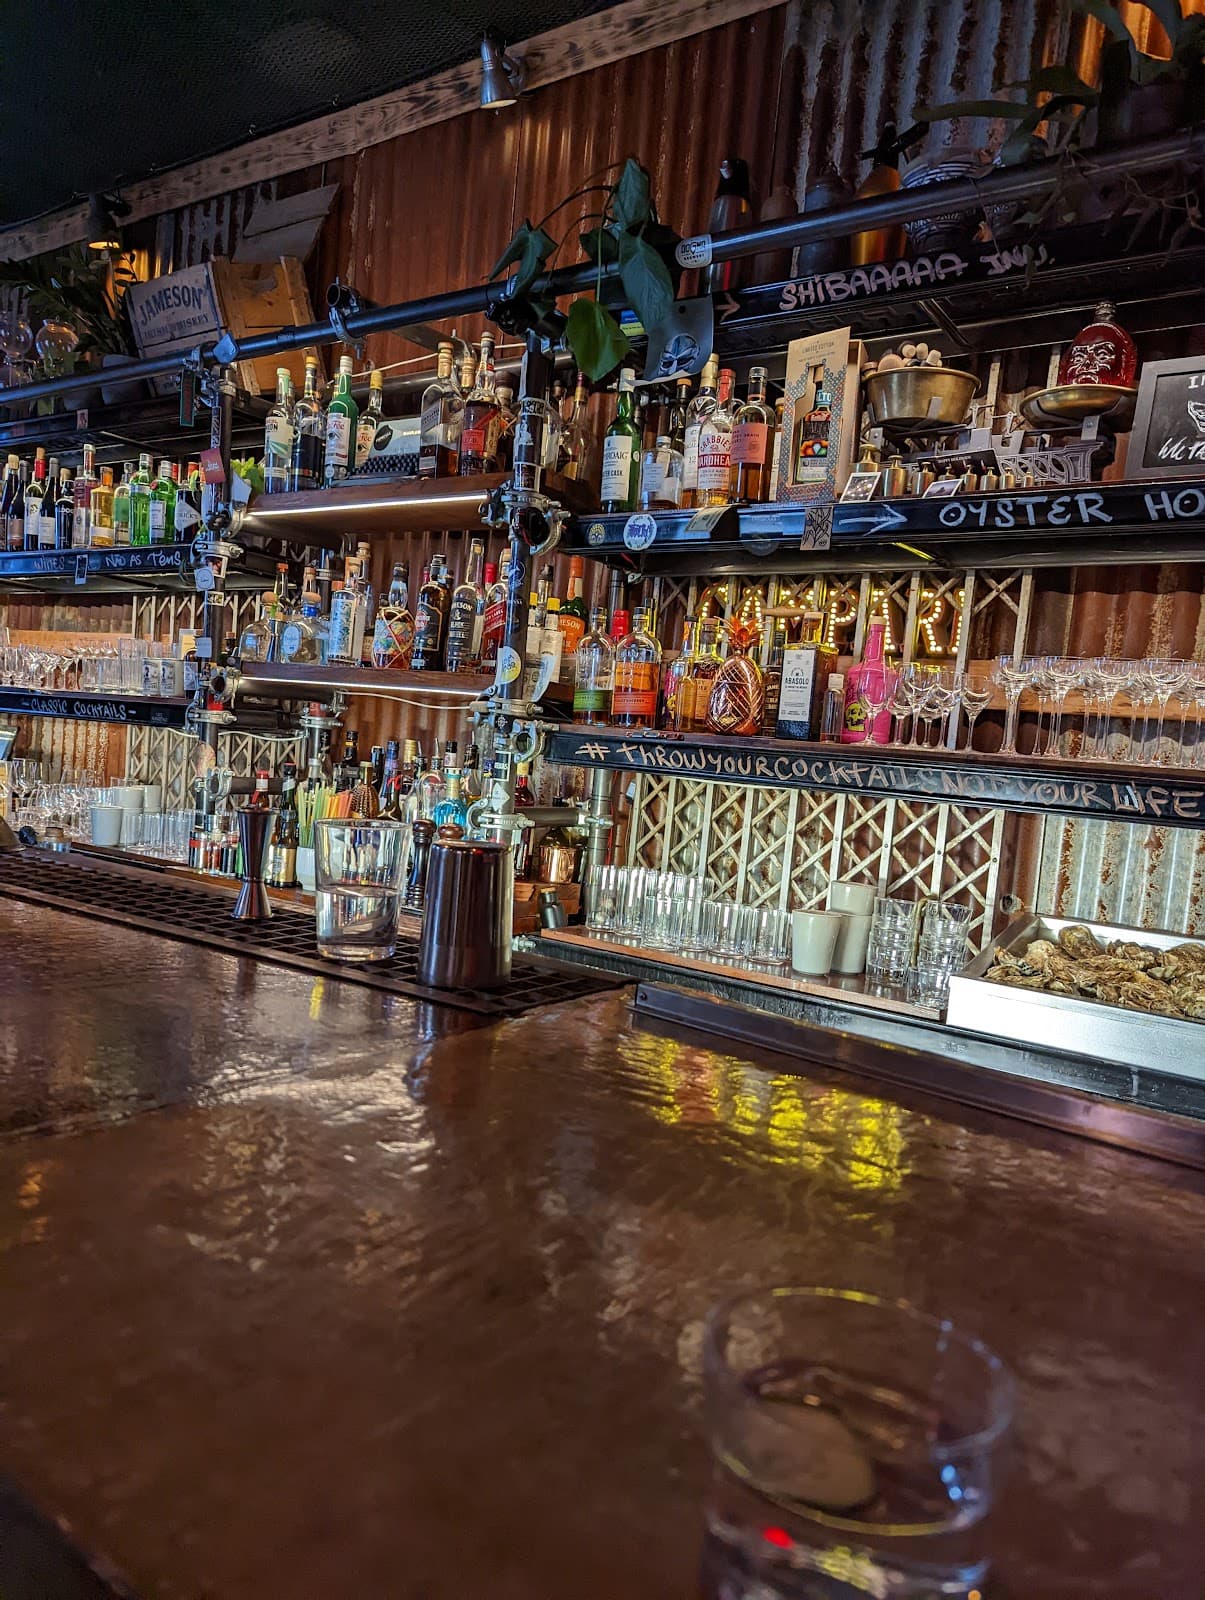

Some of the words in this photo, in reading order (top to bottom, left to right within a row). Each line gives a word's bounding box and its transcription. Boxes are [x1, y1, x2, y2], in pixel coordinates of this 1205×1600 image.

[139, 285, 203, 326] JAMESON
[699, 454, 731, 467] ARDHEA
[939, 491, 1113, 528] OYSTER
[785, 676, 809, 686] ABASOLO
